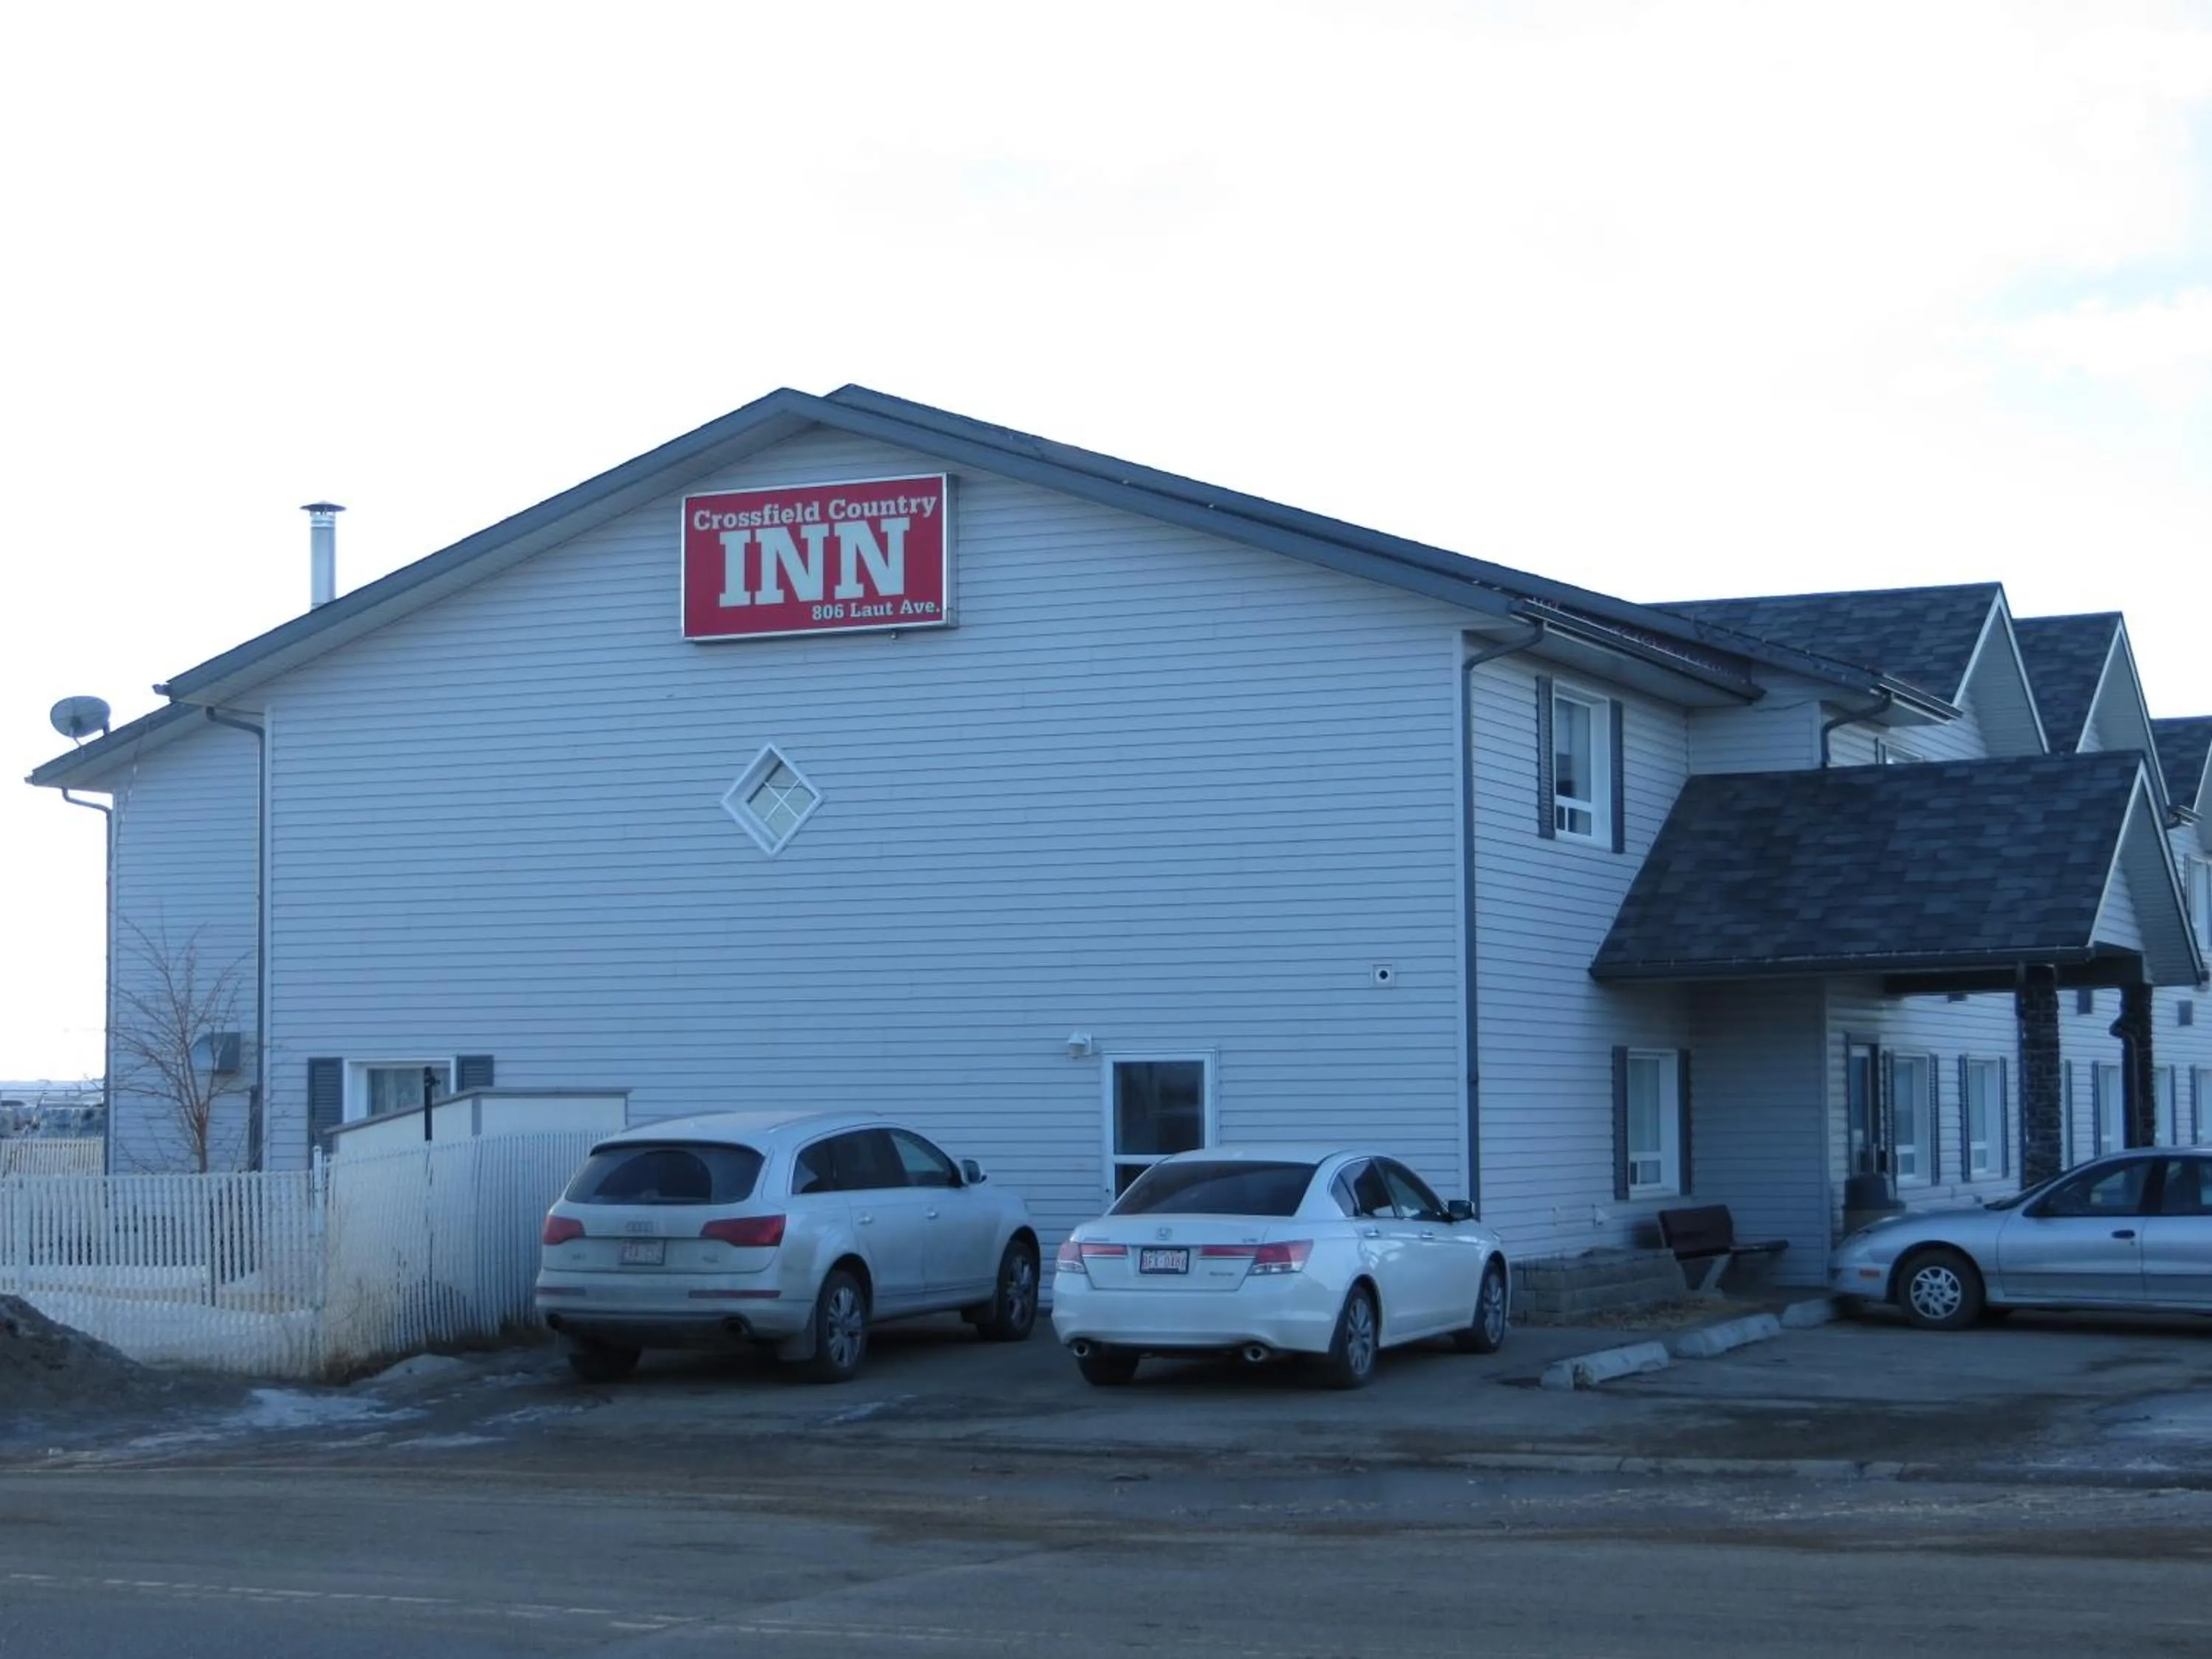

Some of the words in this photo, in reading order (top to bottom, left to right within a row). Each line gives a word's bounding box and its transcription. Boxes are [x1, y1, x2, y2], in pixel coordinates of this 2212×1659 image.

[694, 502, 819, 530] Crossfield
[828, 495, 937, 518] Country
[719, 518, 911, 608] INN
[812, 605, 844, 621] 806
[849, 602, 893, 618] Laut
[899, 599, 941, 614] Ave.
